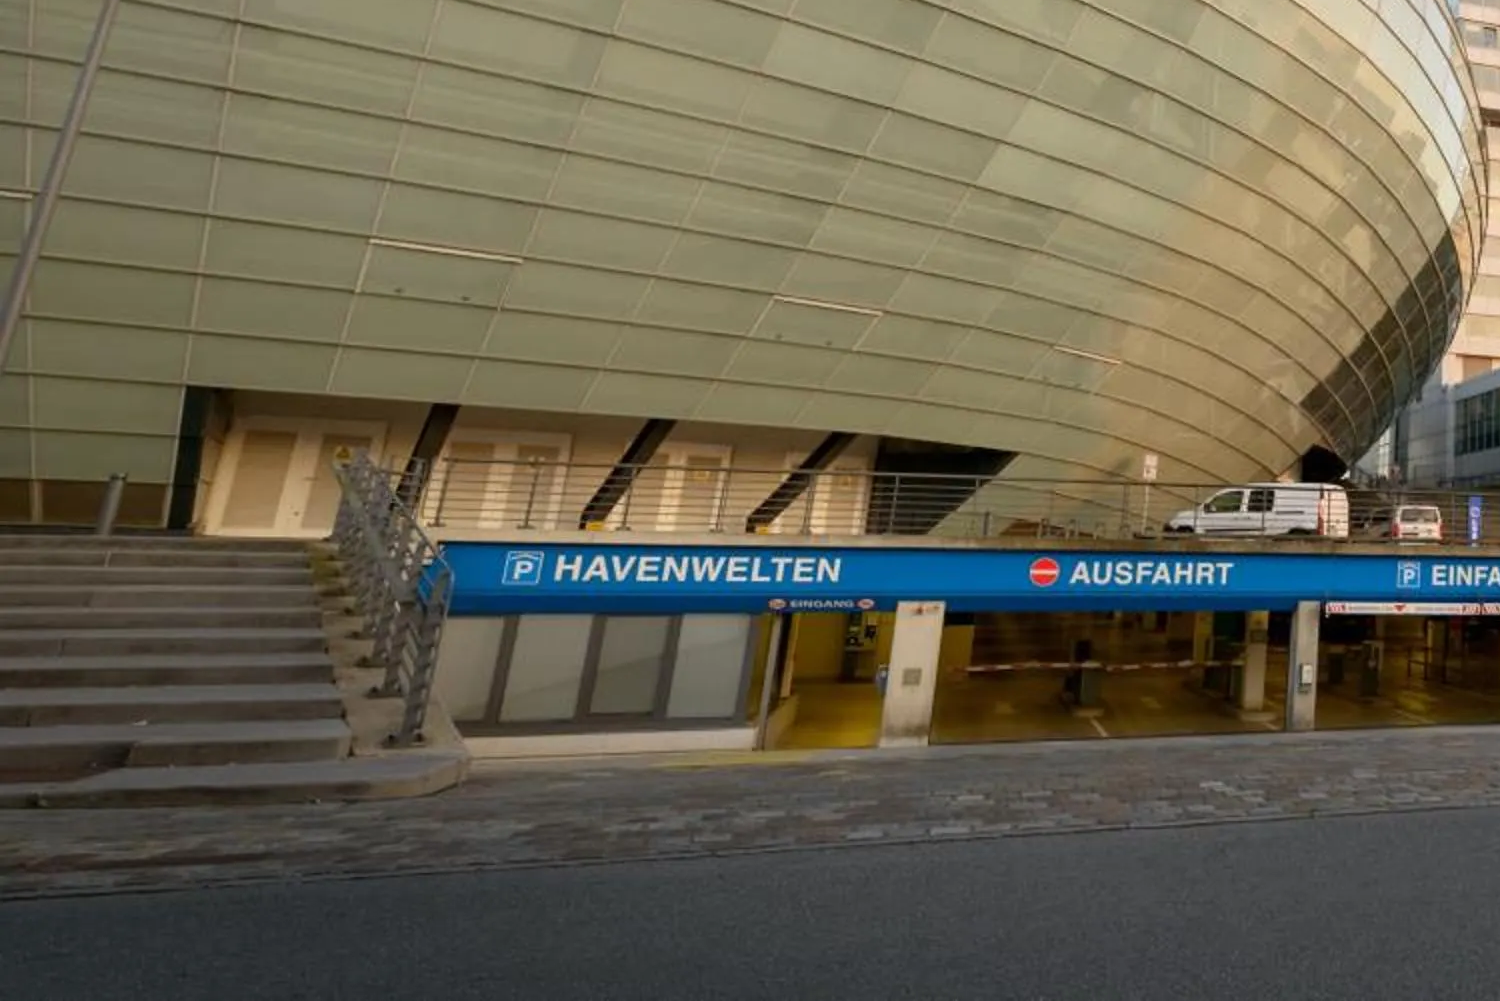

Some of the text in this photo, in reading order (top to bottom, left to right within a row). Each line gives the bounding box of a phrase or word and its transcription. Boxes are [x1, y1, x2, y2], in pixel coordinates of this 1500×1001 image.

[513, 554, 842, 583] P HAVENWELTEN
[1069, 561, 1235, 585] AUSFAHRT
[1403, 569, 1416, 585] P
[790, 599, 854, 609] EINGANG
